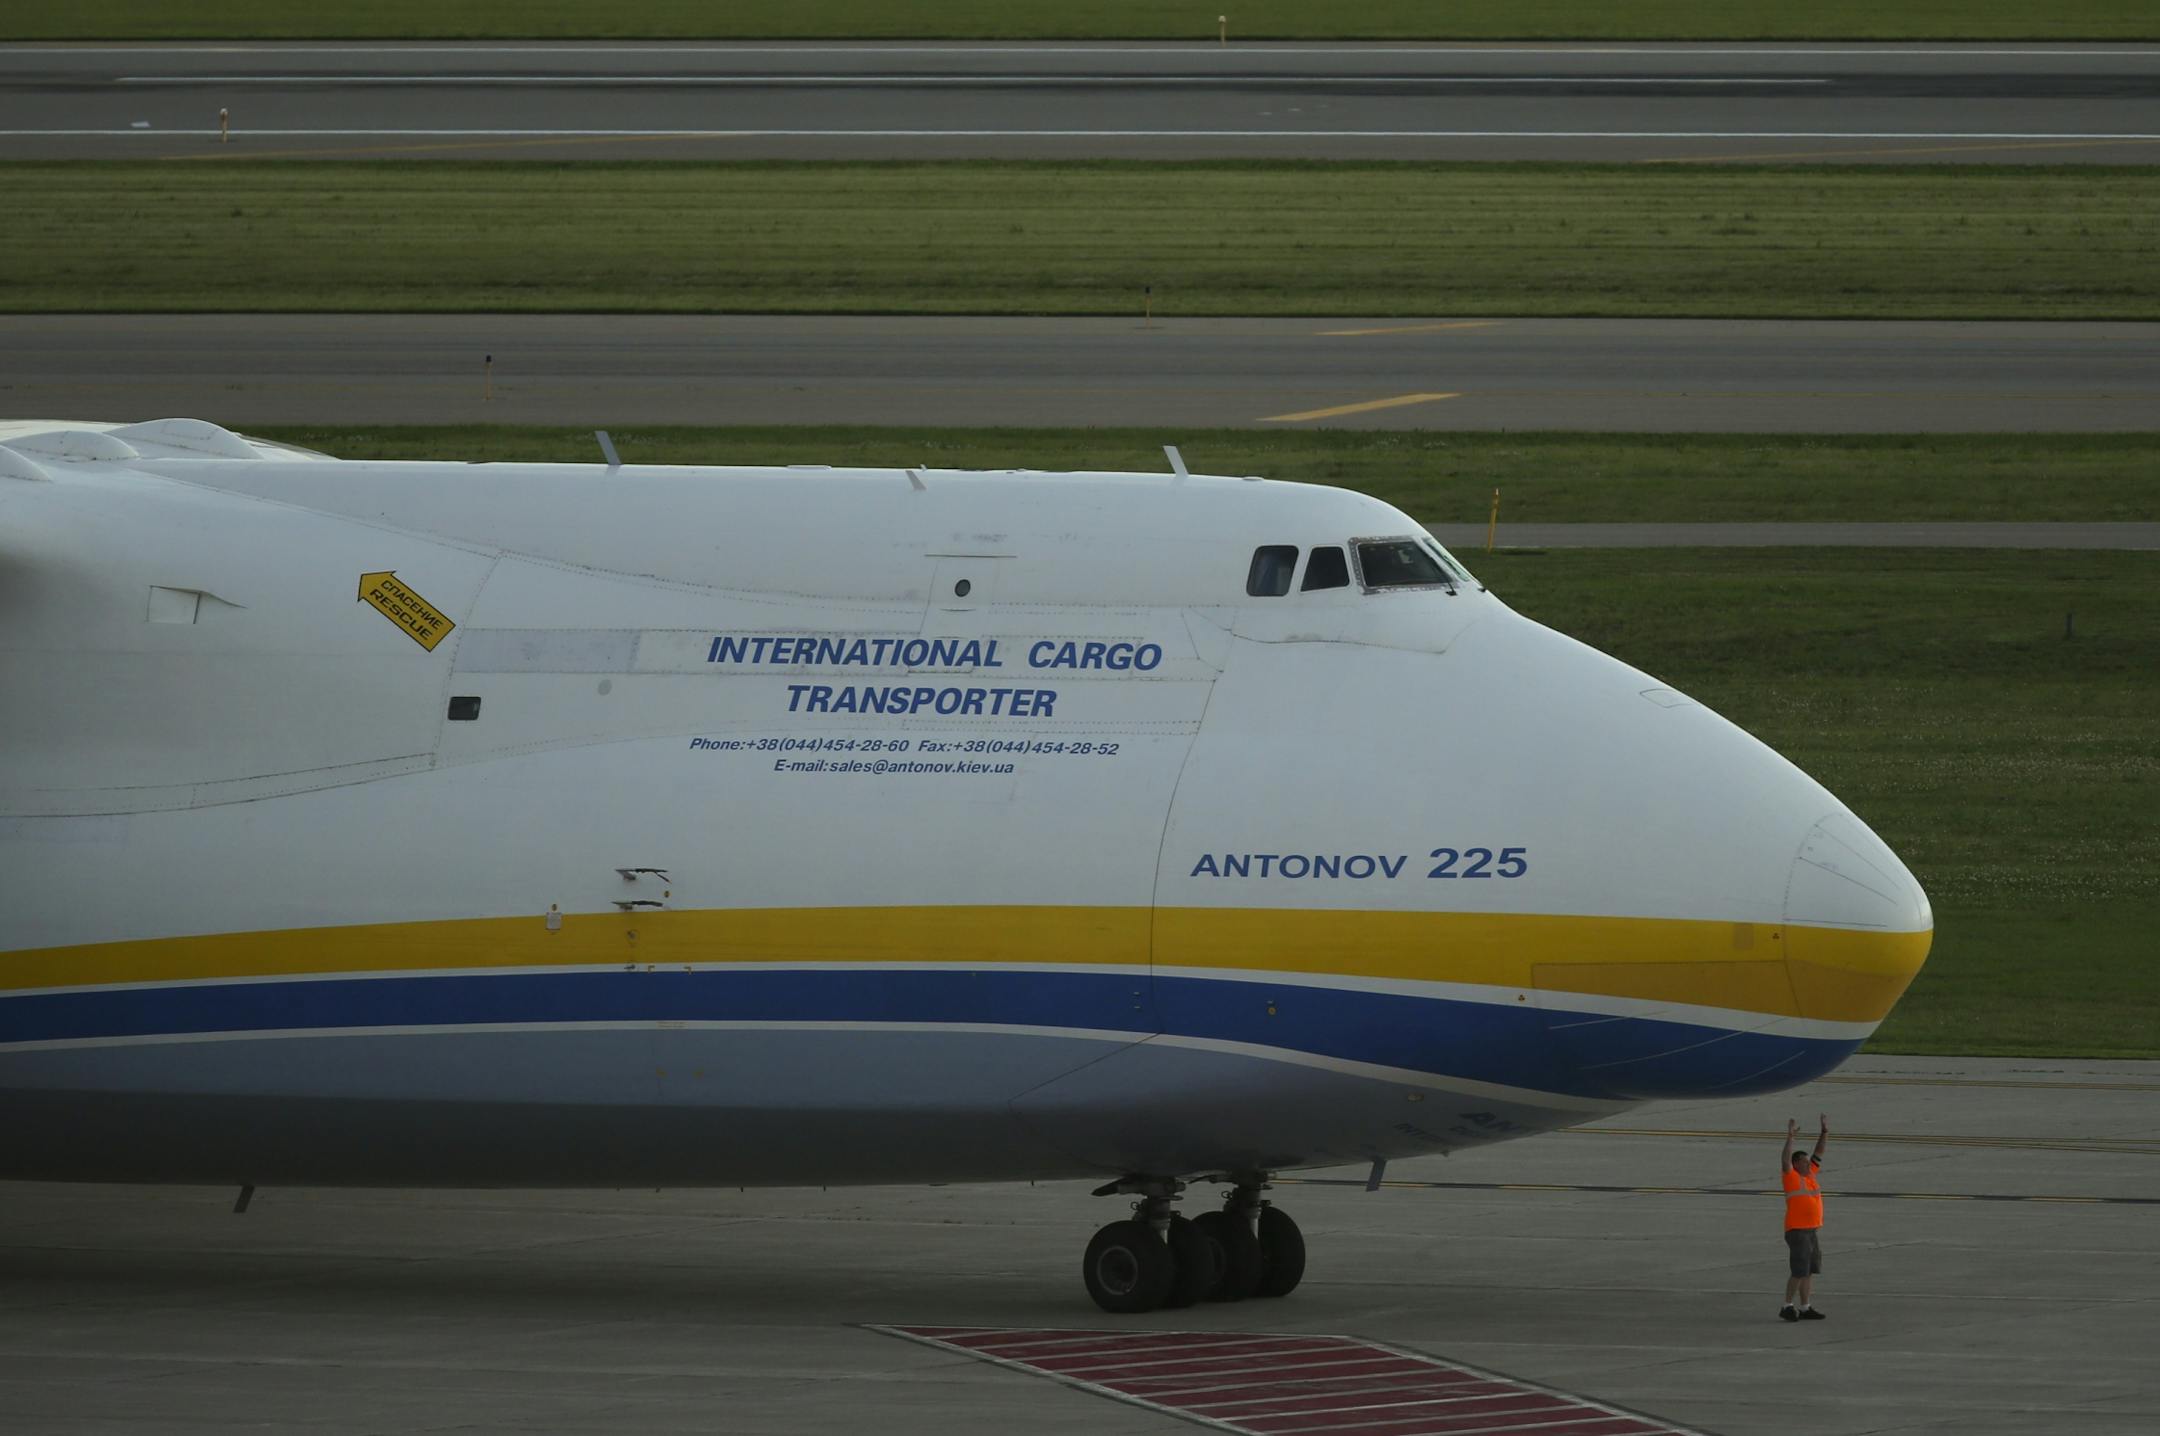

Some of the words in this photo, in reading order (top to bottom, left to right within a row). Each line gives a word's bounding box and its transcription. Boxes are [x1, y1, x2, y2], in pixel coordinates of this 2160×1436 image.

[369, 588, 433, 641] RESCUE
[380, 580, 443, 630] СПАСЕНИЕ
[707, 637, 1003, 668] INTERNATIONAL
[1027, 641, 1163, 672] CARGO
[786, 685, 1058, 717] TRANSPORTER
[1190, 853, 1408, 879] ANTONOV
[1427, 847, 1528, 879] 225
